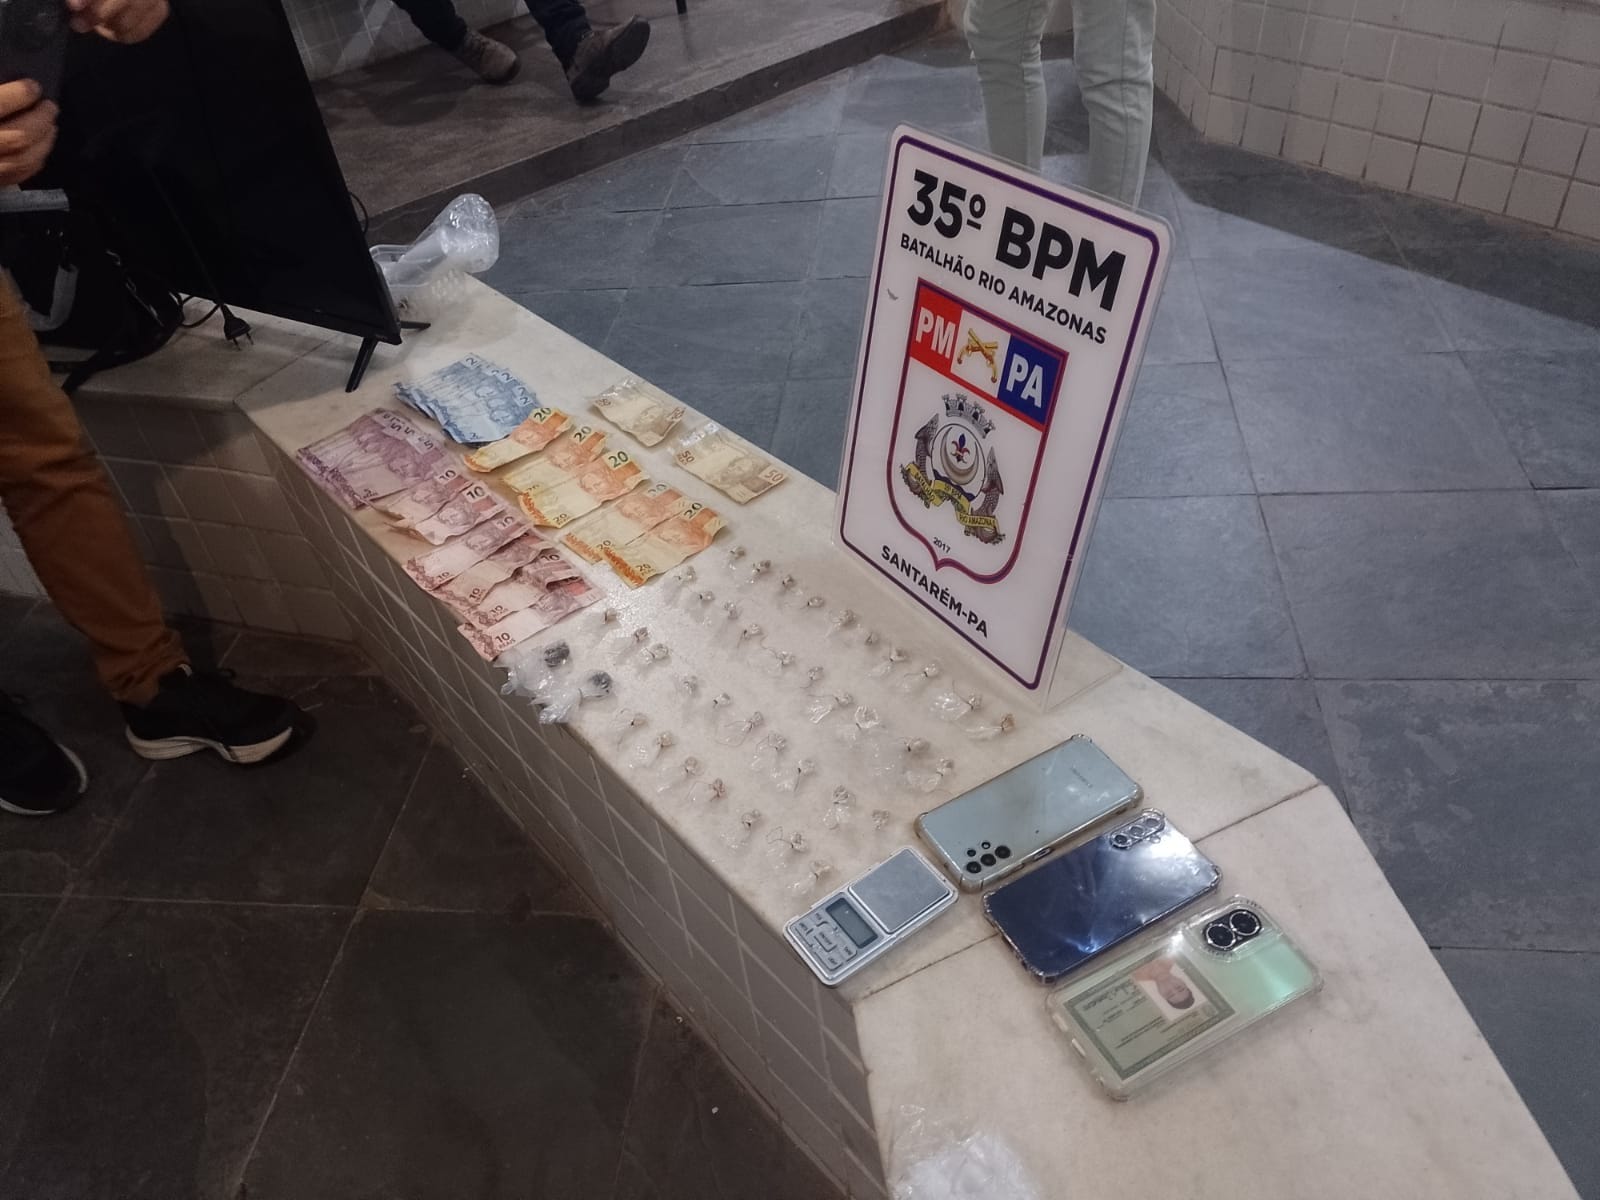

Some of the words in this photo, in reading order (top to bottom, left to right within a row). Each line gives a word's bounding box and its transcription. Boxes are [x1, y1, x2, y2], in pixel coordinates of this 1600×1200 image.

[907, 169, 986, 239] 35º
[995, 206, 1126, 312] BPM
[900, 233, 975, 282] BATALHÃO
[978, 269, 1006, 295] RIO
[1009, 286, 1107, 344] AMAZONAS
[915, 306, 956, 359] PM
[1006, 353, 1044, 408] PA
[533, 407, 551, 422] 20
[573, 426, 592, 442] 20
[608, 451, 629, 468] 20
[681, 450, 695, 463] 50
[439, 470, 457, 481] 10
[764, 469, 784, 482] 50
[466, 486, 486, 500] 10
[683, 502, 703, 519] 20
[933, 537, 951, 553] 2017
[469, 587, 481, 599] 10
[881, 545, 988, 638] SANTARÉM-PA
[490, 605, 504, 615] 10
[495, 632, 510, 643] 10
